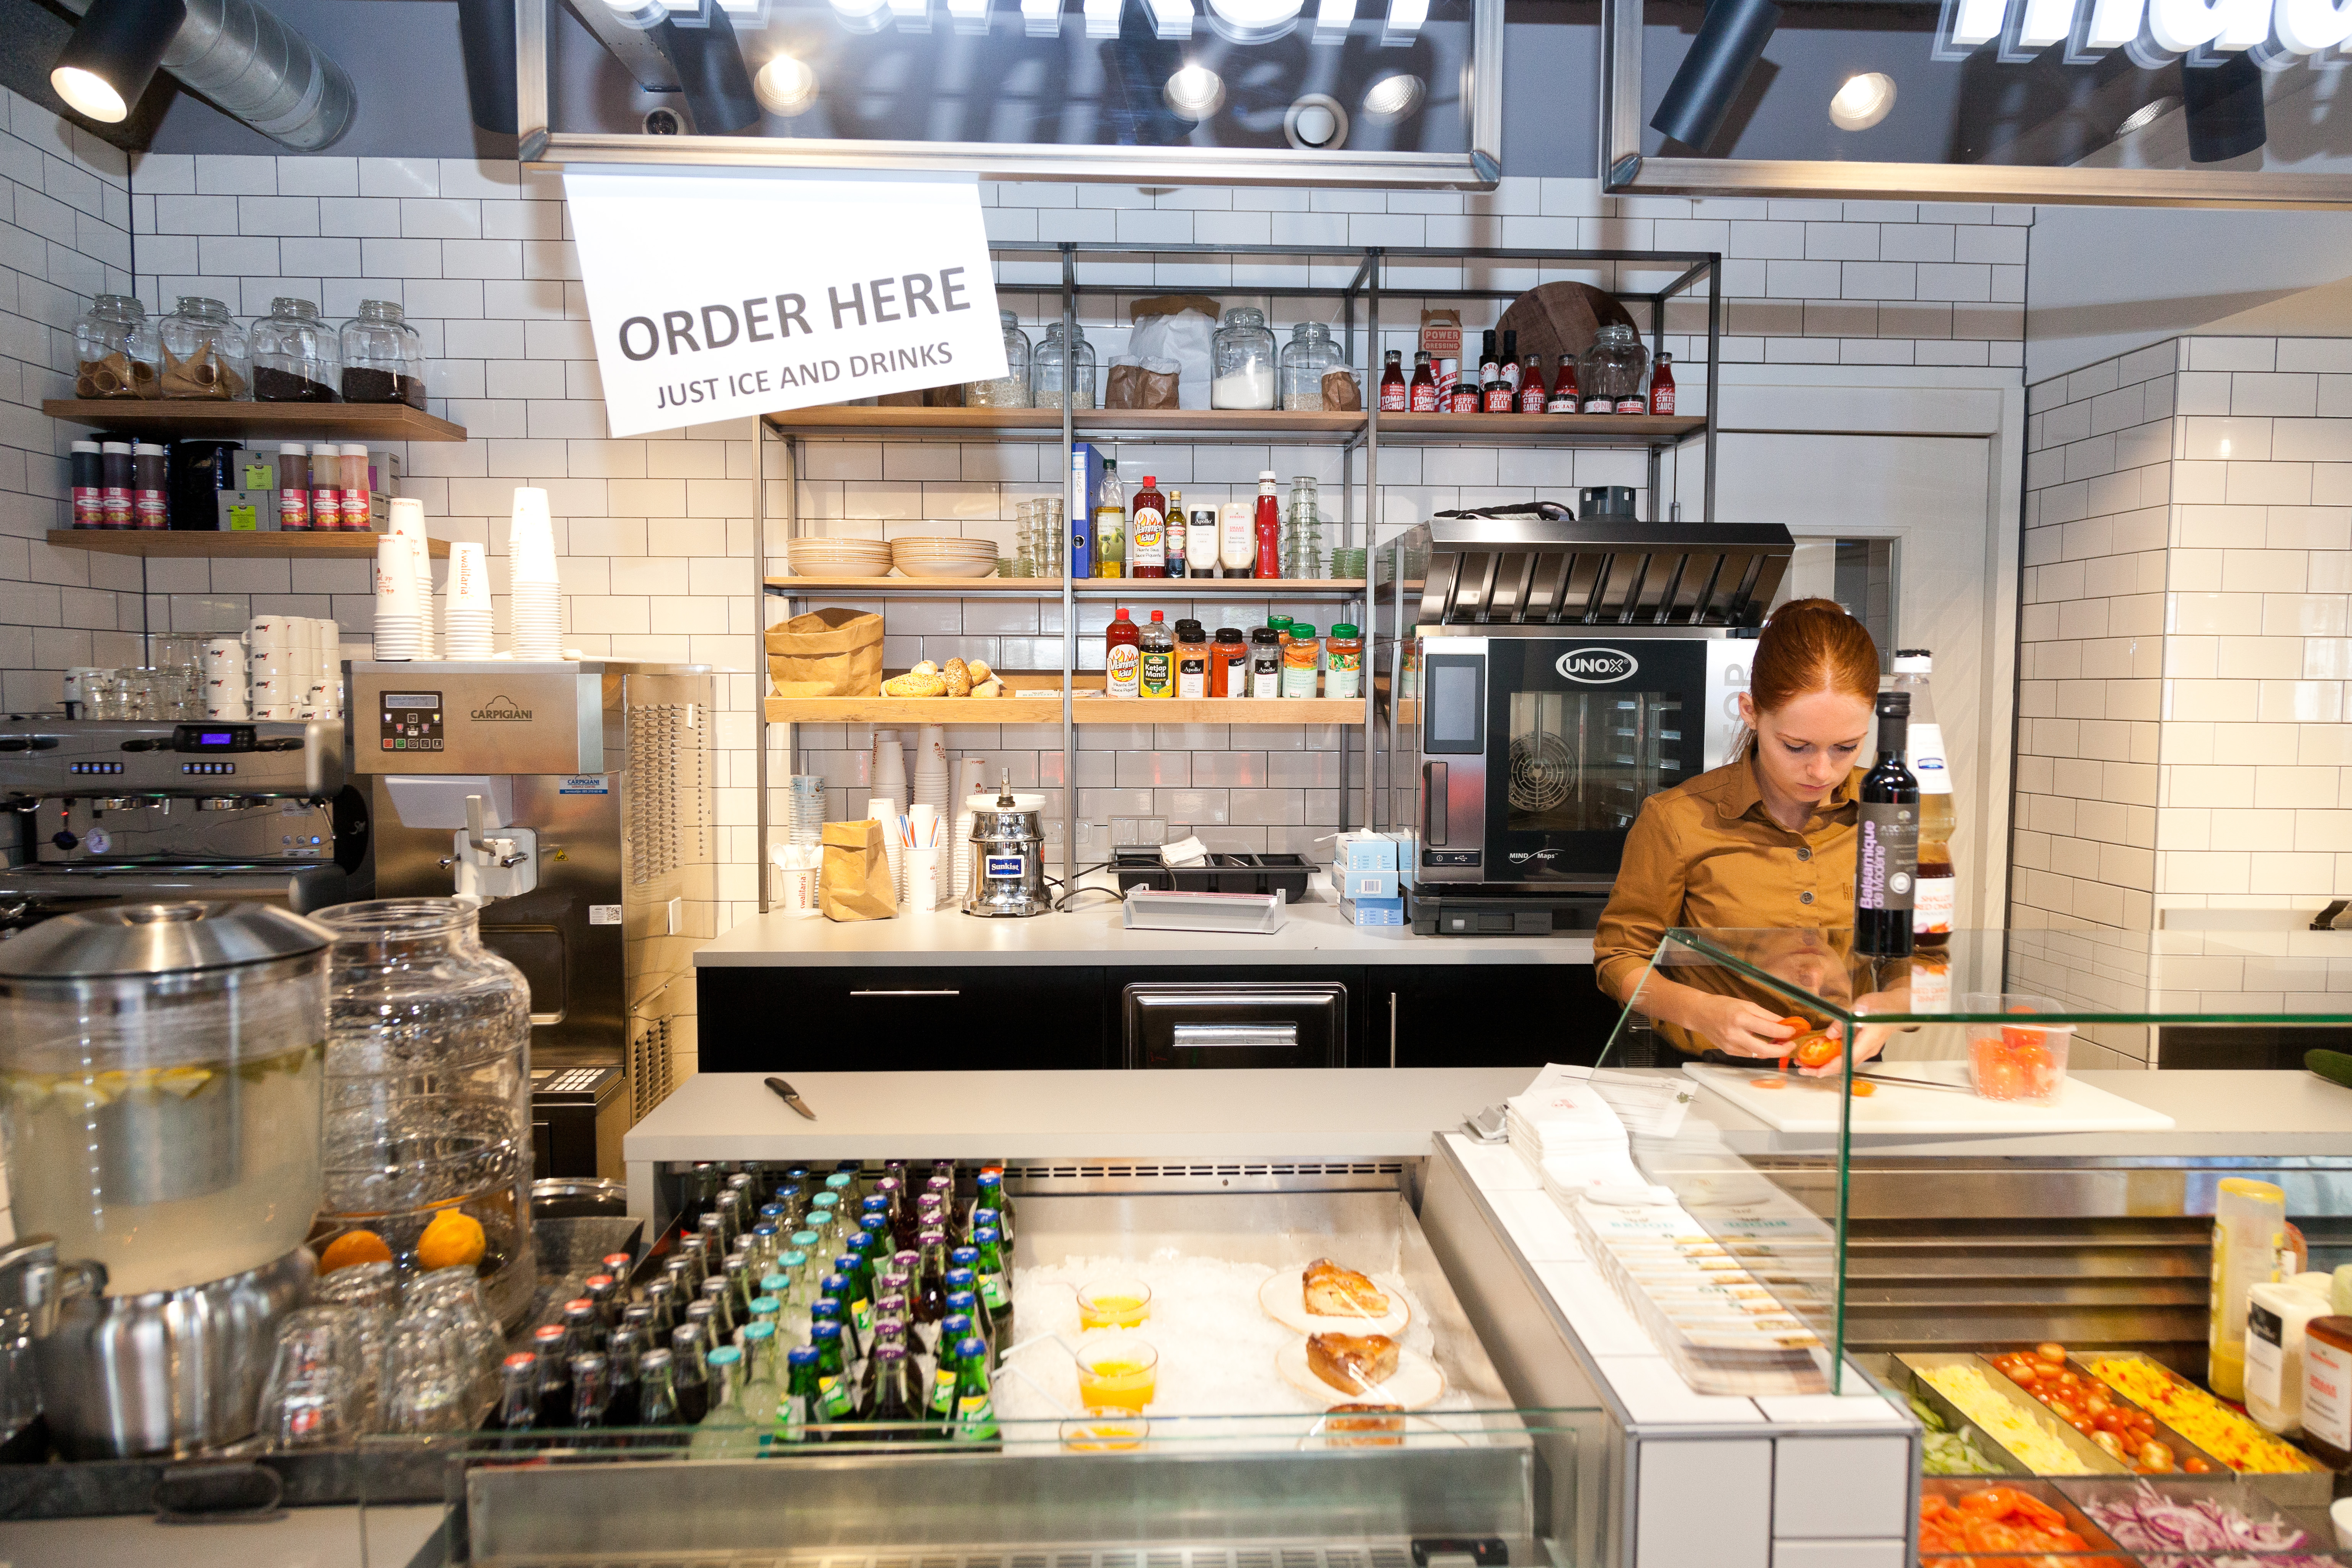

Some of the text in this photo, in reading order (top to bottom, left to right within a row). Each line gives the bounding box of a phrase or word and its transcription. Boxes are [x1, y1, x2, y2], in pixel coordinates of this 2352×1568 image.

[618, 266, 971, 361] ORDER HERE
[1426, 331, 1458, 339] POWER
[657, 341, 954, 409] JUST ICE AND DRINKS
[1381, 395, 1404, 405] TOMATO
[1414, 396, 1434, 406] TOMAT
[1490, 400, 1508, 409] JELLY
[1381, 401, 1404, 410] KETCHUP
[1454, 403, 1472, 412] JELLY
[1523, 403, 1540, 412] SAUCE
[1656, 403, 1674, 411] SAUCE
[1134, 523, 1163, 536] Vlammen
[1141, 533, 1155, 542] saus
[461, 549, 471, 595] kwalitaria
[1109, 658, 1139, 670] Vlammen
[1145, 664, 1166, 673] Ketjap
[1566, 658, 1623, 673] UNOX
[1118, 669, 1132, 677] saus
[471, 710, 532, 719] CARPIGIANI
[991, 862, 1019, 871] Sunkist
[1860, 820, 1877, 909] Balsamique
[1874, 892, 1884, 908] de
